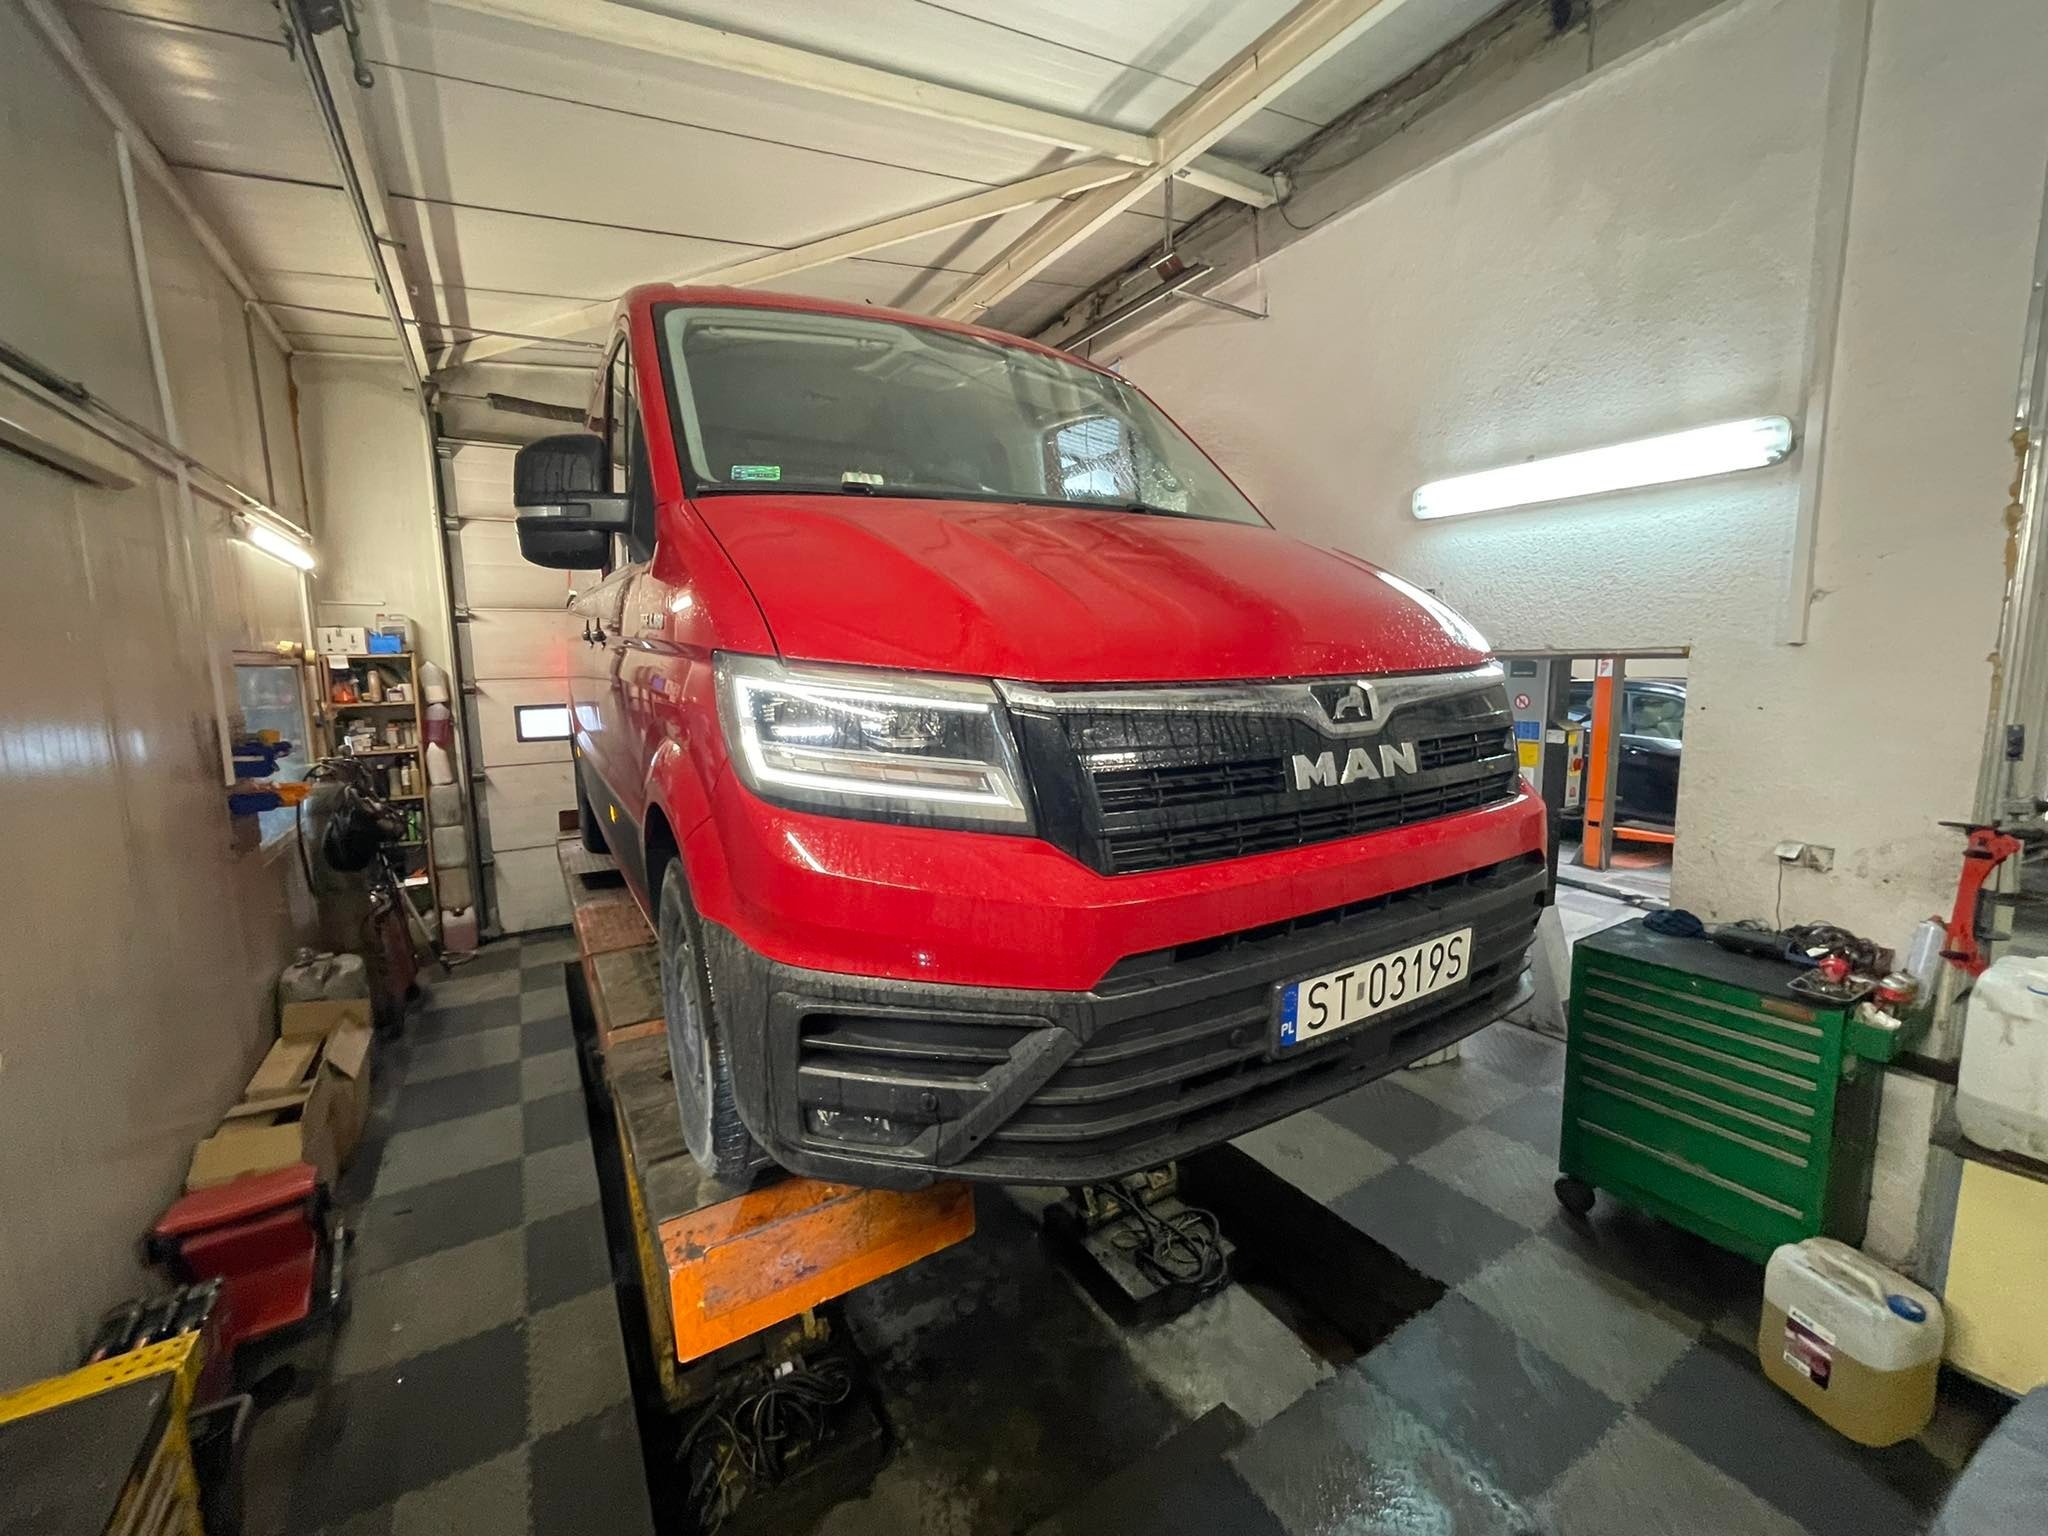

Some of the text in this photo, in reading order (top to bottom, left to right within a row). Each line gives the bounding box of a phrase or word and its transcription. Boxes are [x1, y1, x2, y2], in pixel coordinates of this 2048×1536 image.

[1292, 742, 1417, 790] MAN
[1307, 936, 1463, 1030] ST 0319S
[1280, 1021, 1295, 1037] PL
